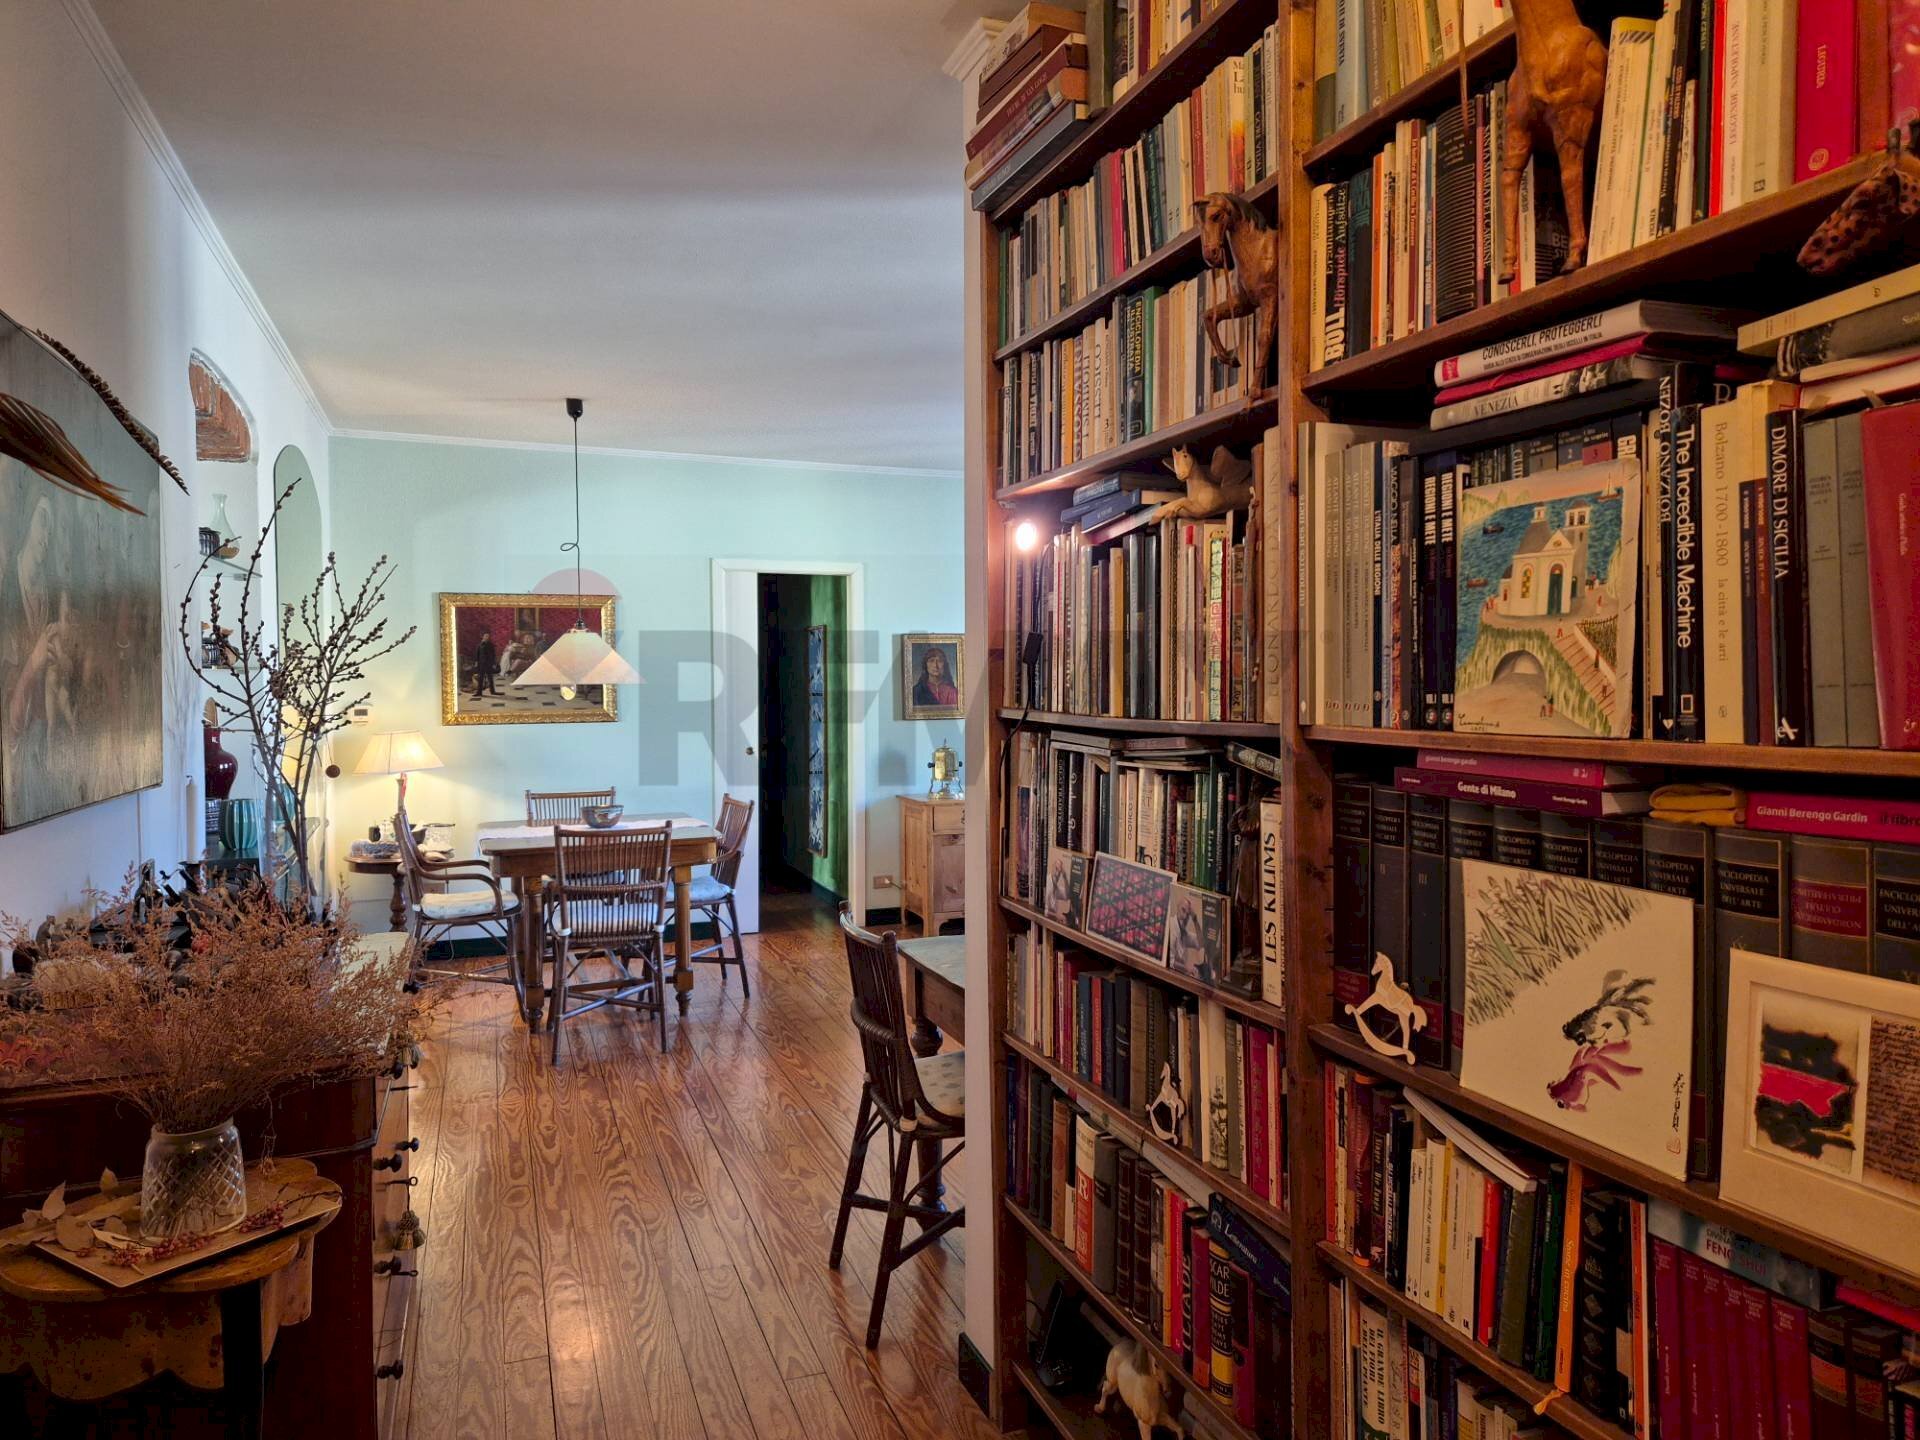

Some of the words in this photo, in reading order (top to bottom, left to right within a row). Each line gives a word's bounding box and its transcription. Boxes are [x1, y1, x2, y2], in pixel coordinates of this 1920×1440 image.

[1539, 314, 1603, 344] PROTEGGERLI
[1083, 355, 1091, 430] SIMBOLI
[1474, 396, 1519, 417] VENEZIA
[1659, 376, 1672, 434] BOZEN
[1676, 424, 1695, 468] The
[1715, 422, 1728, 480] Bolzano
[1772, 425, 1787, 501] DIMORE
[1424, 476, 1436, 514] REGIONI
[1441, 472, 1454, 510] REGIONI
[1659, 441, 1672, 523] BOLZANO
[1441, 519, 1454, 543] METE
[1676, 470, 1695, 562] Incredible
[1773, 504, 1788, 517] DI
[1425, 522, 1436, 546] METE
[1774, 520, 1791, 579] SICILIA
[1677, 565, 1696, 649] Machine
[1266, 561, 1279, 698] LEONARDO
[1718, 643, 1728, 663] arti
[1458, 781, 1480, 793] Gente
[1490, 785, 1517, 799] Milano
[1757, 806, 1788, 817] Gianni
[1789, 808, 1832, 821] Berengo
[1833, 811, 1868, 823] Gardin
[1263, 832, 1276, 914] KILIMS
[1265, 922, 1277, 964] LES
[1376, 1341, 1384, 1388] GRANDE
[1377, 1390, 1385, 1425] LIBRO
